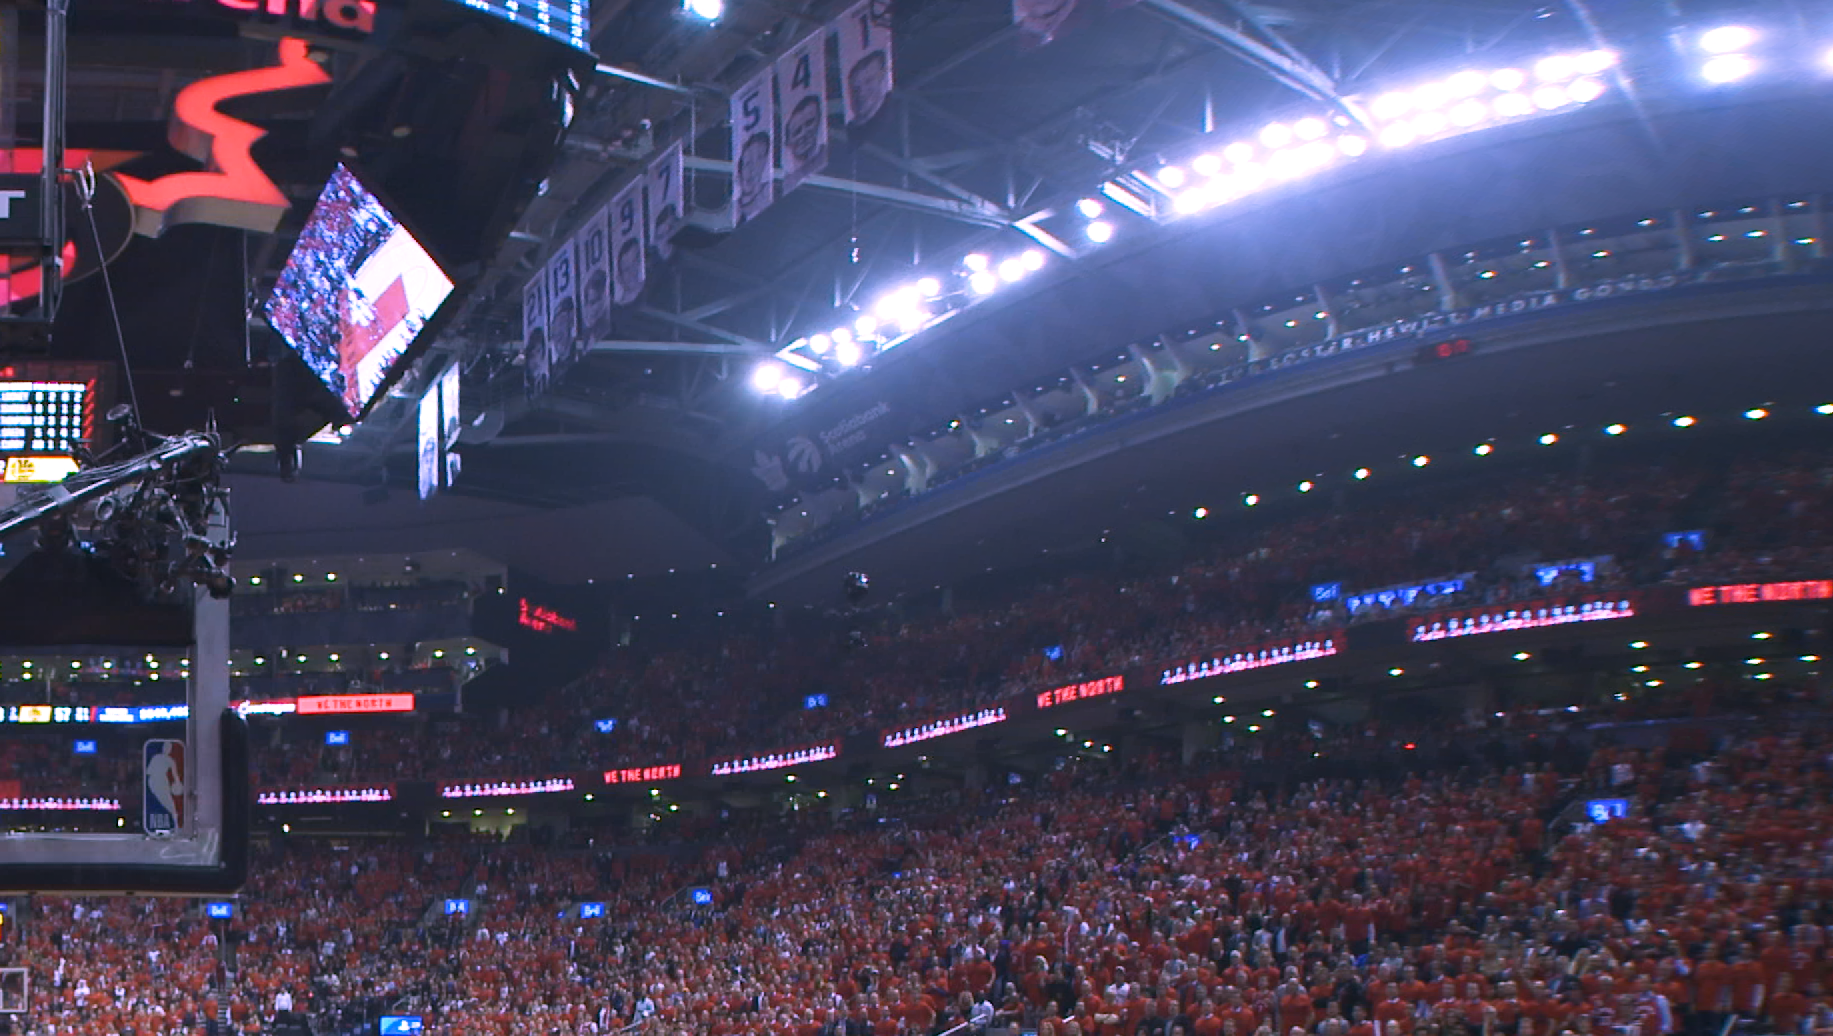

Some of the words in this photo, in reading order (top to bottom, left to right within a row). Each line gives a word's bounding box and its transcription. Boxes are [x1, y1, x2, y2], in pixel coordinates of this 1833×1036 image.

[790, 53, 811, 91] 4
[742, 90, 761, 131] 5
[621, 199, 635, 236] 9
[584, 230, 604, 271] 10
[553, 258, 571, 297] 13
[150, 813, 171, 829] NBA
